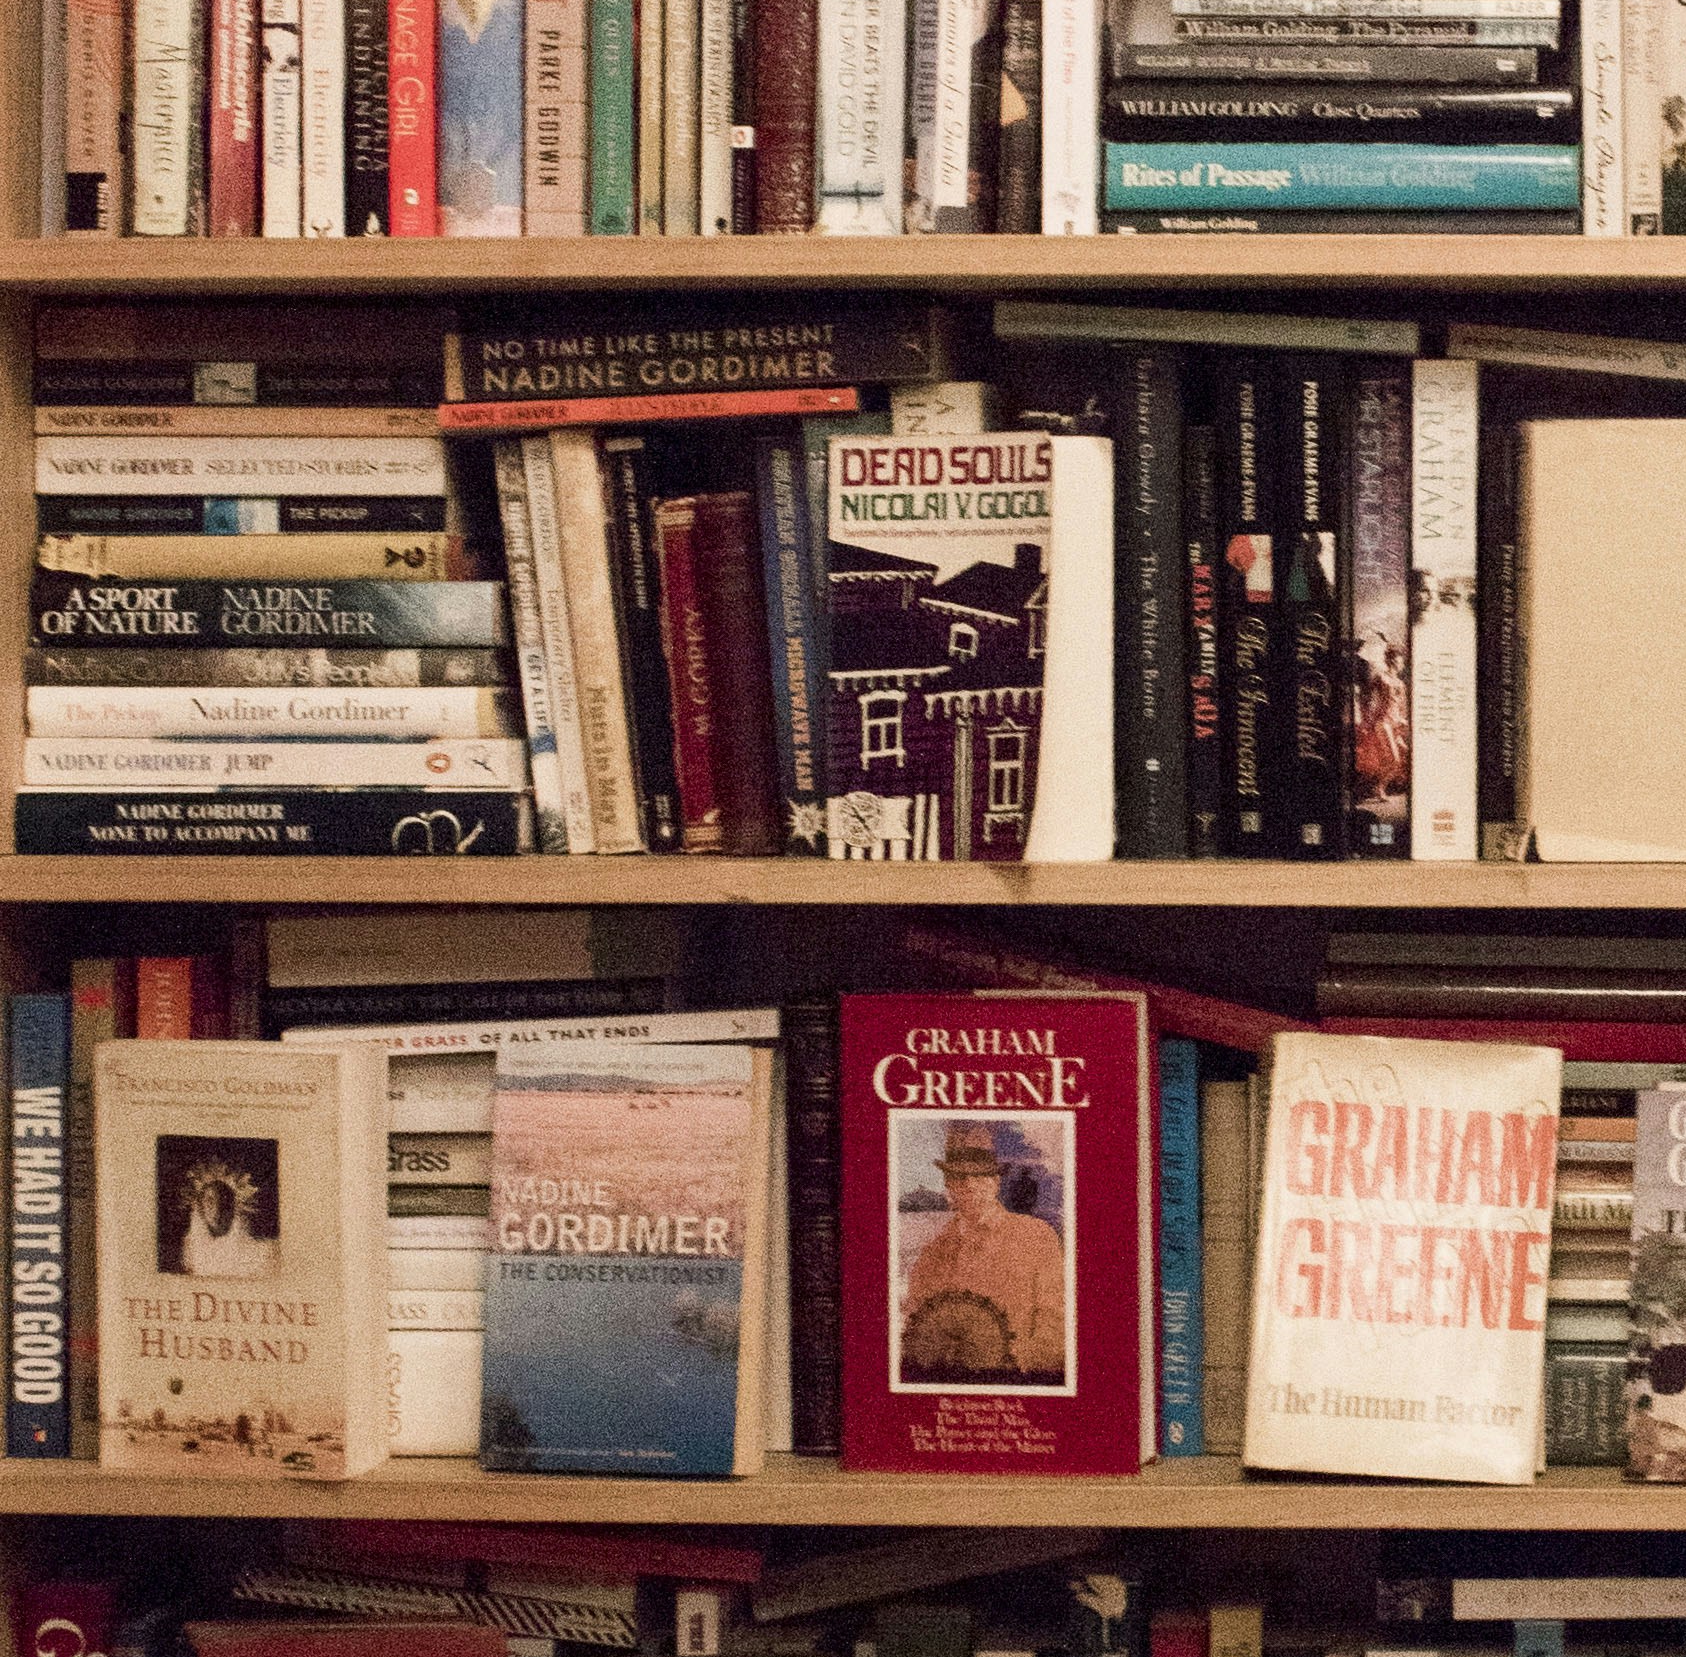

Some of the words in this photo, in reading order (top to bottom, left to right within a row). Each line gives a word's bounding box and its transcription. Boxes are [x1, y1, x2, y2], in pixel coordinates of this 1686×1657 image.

[537, 29, 562, 92] PARKE
[1062, 52, 1075, 86] Flies
[537, 106, 562, 187] GODWIN
[482, 339, 525, 360] NO
[535, 336, 596, 359] TIME
[604, 334, 663, 355] LIKE
[669, 329, 715, 350] THE
[724, 324, 834, 347] PRESENT
[482, 360, 623, 391] NADINE
[639, 351, 834, 388] GORDIMER
[840, 445, 944, 486] DEAD
[948, 444, 1053, 486] SOULS
[1418, 380, 1443, 540] GRAHAM
[1444, 381, 1465, 544] BRENDAN
[66, 587, 87, 612] A
[88, 587, 178, 612] SPORT
[221, 587, 333, 612] NADINE
[41, 612, 82, 635] OF
[84, 612, 199, 635] NATURE
[220, 611, 377, 636] GORDIMER
[906, 1026, 1057, 1058] GRAHAM
[872, 1055, 1091, 1109] GREENE
[14, 1085, 62, 1138] WE
[1286, 1099, 1560, 1211] GRAHAM
[14, 1146, 62, 1214] HAD
[14, 1221, 62, 1252] IT
[498, 1214, 732, 1257] GORDIMER
[14, 1259, 63, 1304] SO
[1272, 1217, 1548, 1332] GREENE
[124, 1296, 184, 1323] THE
[190, 1291, 319, 1328] DIVINE
[14, 1309, 63, 1404] GOOD
[138, 1328, 310, 1365] HUSBAND
